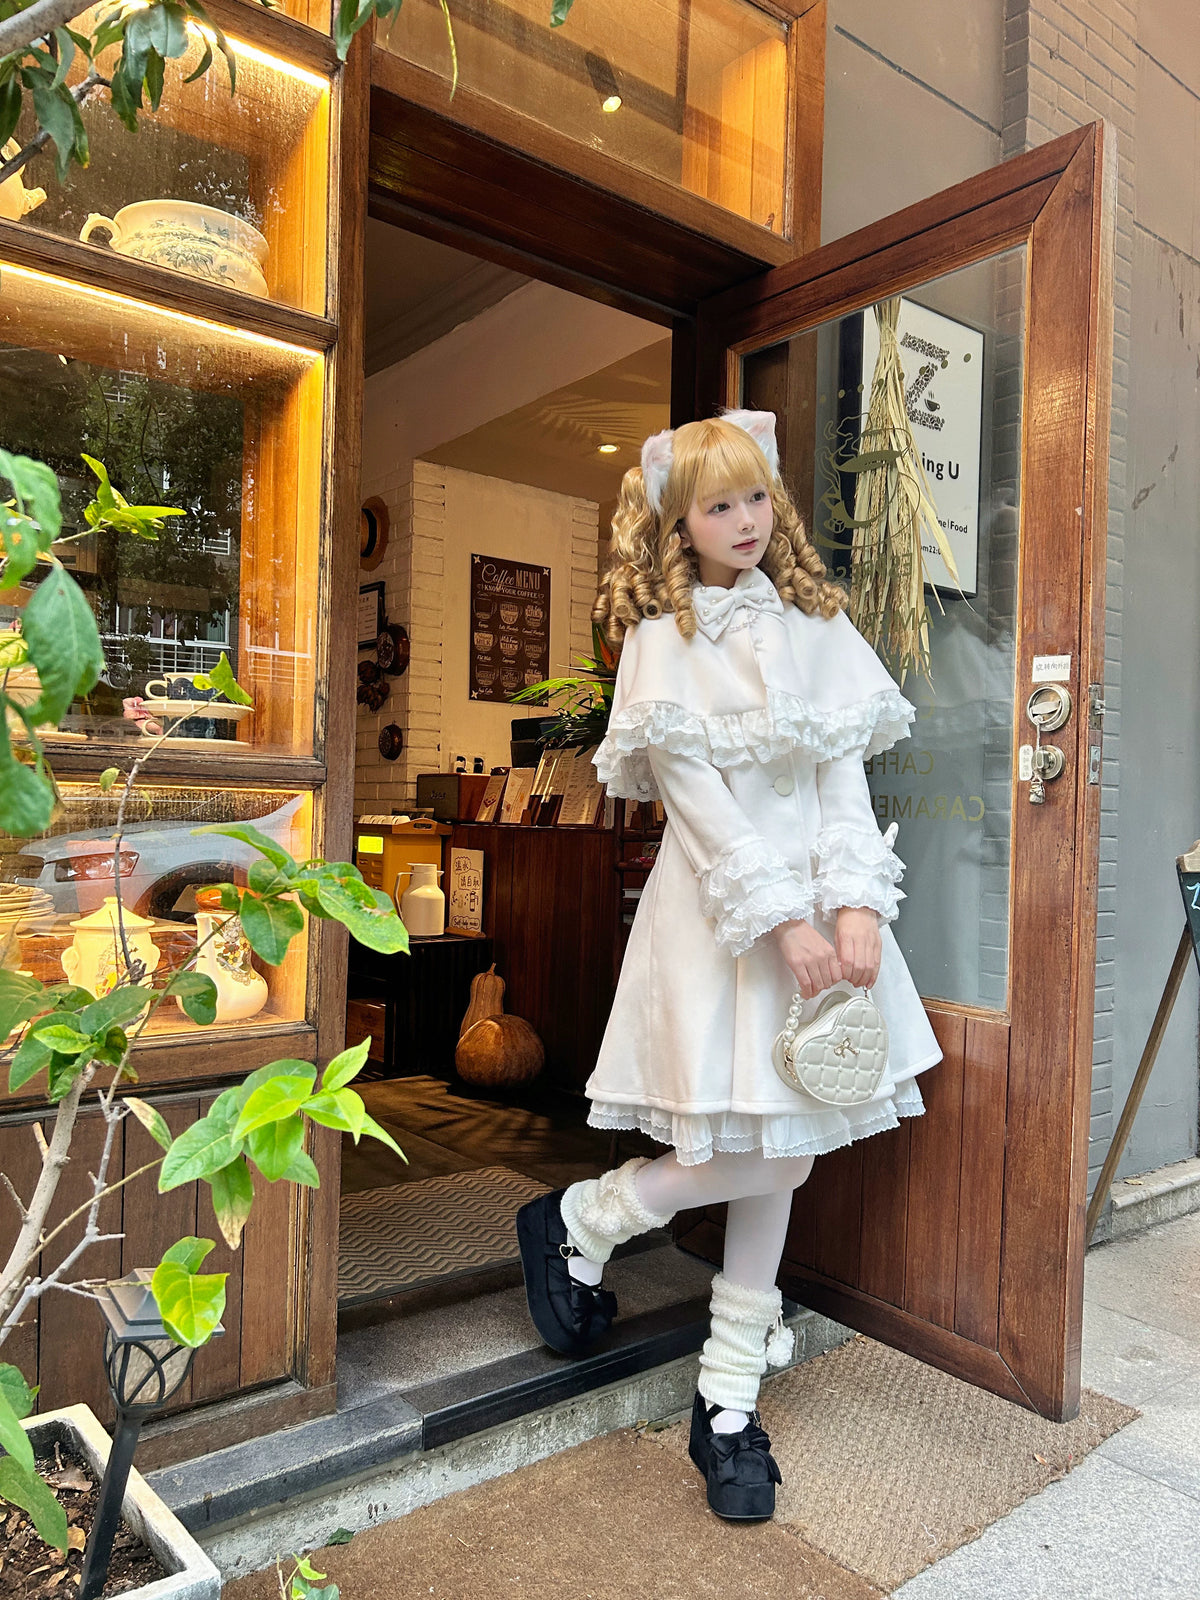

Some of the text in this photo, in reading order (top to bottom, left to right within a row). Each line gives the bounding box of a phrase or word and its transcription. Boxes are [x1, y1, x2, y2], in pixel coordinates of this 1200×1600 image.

[948, 461, 960, 480] U
[481, 563, 541, 591] Coffee MENU
[501, 586, 517, 595] YOUR
[517, 589, 538, 599] COFFEE
